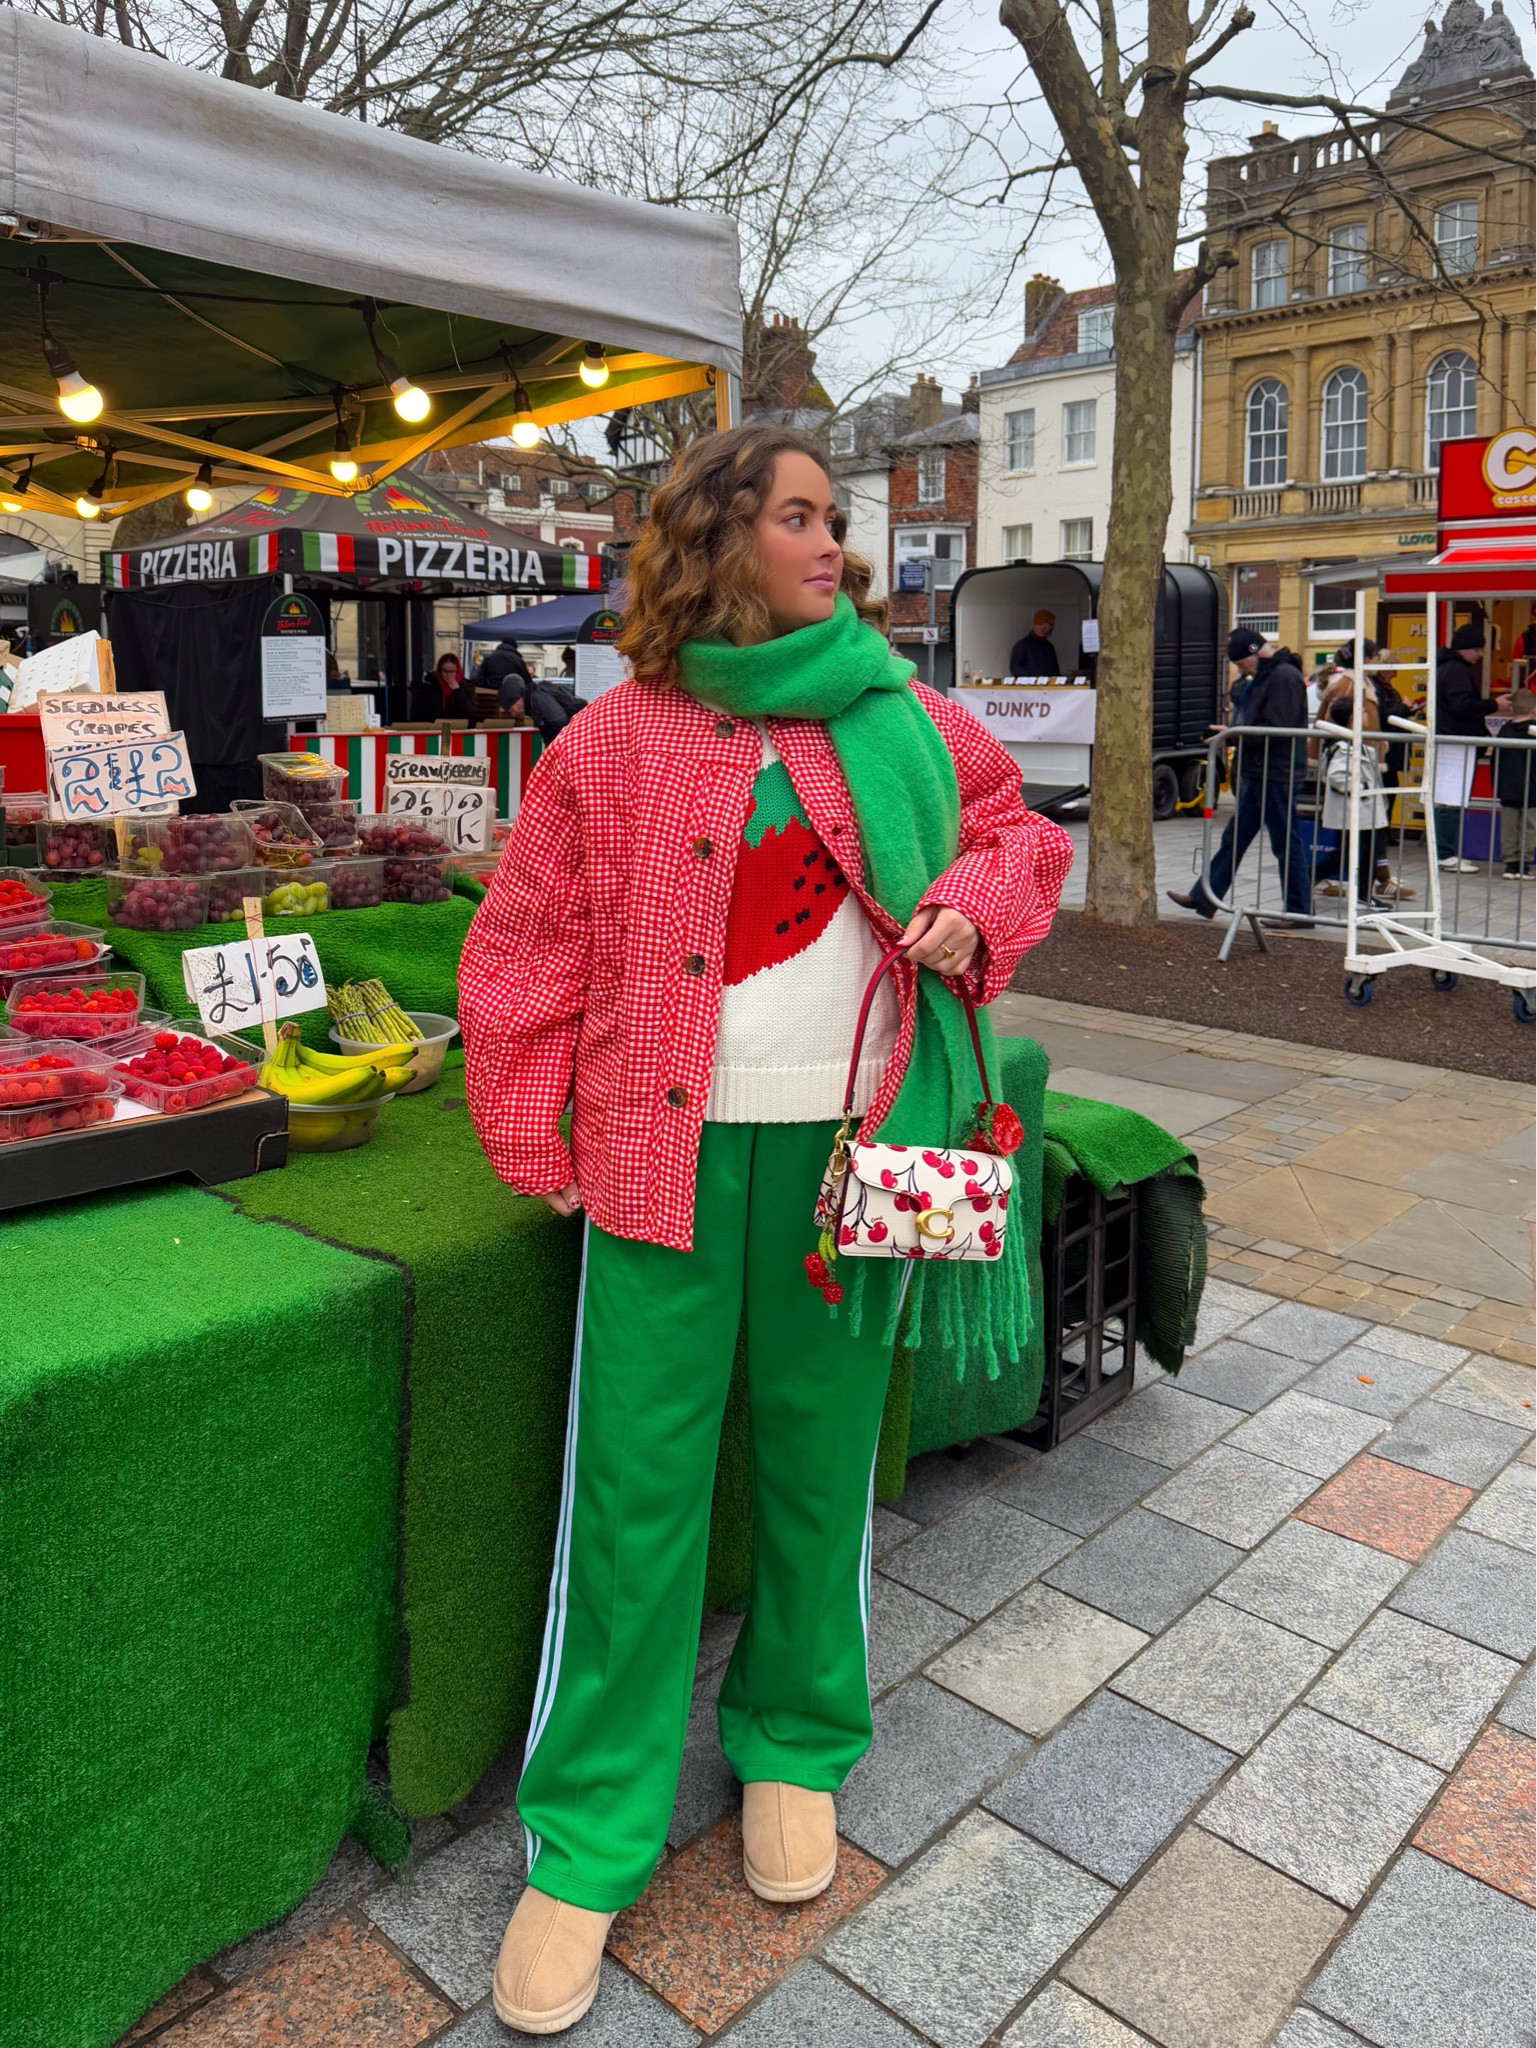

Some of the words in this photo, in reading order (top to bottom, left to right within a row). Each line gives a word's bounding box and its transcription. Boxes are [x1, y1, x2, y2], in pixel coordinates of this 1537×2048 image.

[362, 518, 440, 535] Italian
[436, 519, 491, 538] Food
[140, 541, 237, 587] PIZZERIA
[377, 537, 546, 585] PIZZERIA
[45, 699, 160, 715] SEEDLESS
[985, 701, 1051, 718] DUNK'D
[66, 719, 157, 738] GRAPES
[62, 757, 109, 814] 2
[203, 937, 318, 1024] £1.50
[915, 1208, 954, 1239] C
